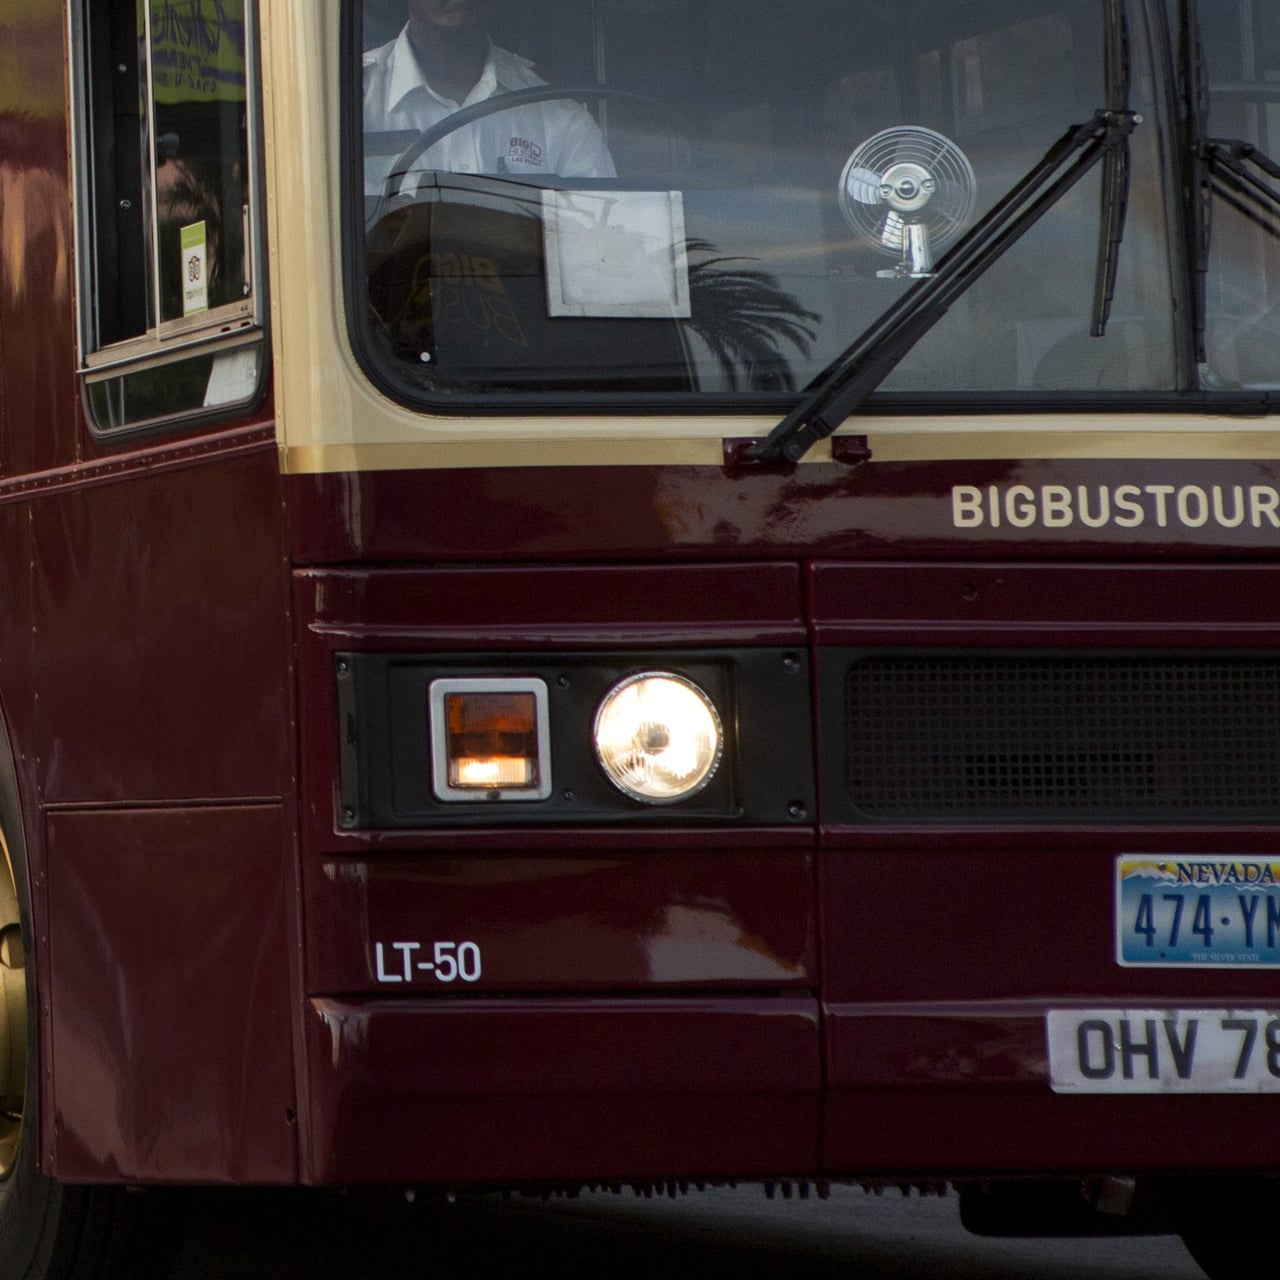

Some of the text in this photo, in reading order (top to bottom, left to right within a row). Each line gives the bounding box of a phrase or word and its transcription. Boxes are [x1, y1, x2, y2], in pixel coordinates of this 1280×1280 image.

[951, 484, 1280, 528] BIGBUSTOUR
[1175, 862, 1276, 884] NEVADA
[376, 941, 482, 983] LT-50
[1077, 1019, 1199, 1080] OHV
